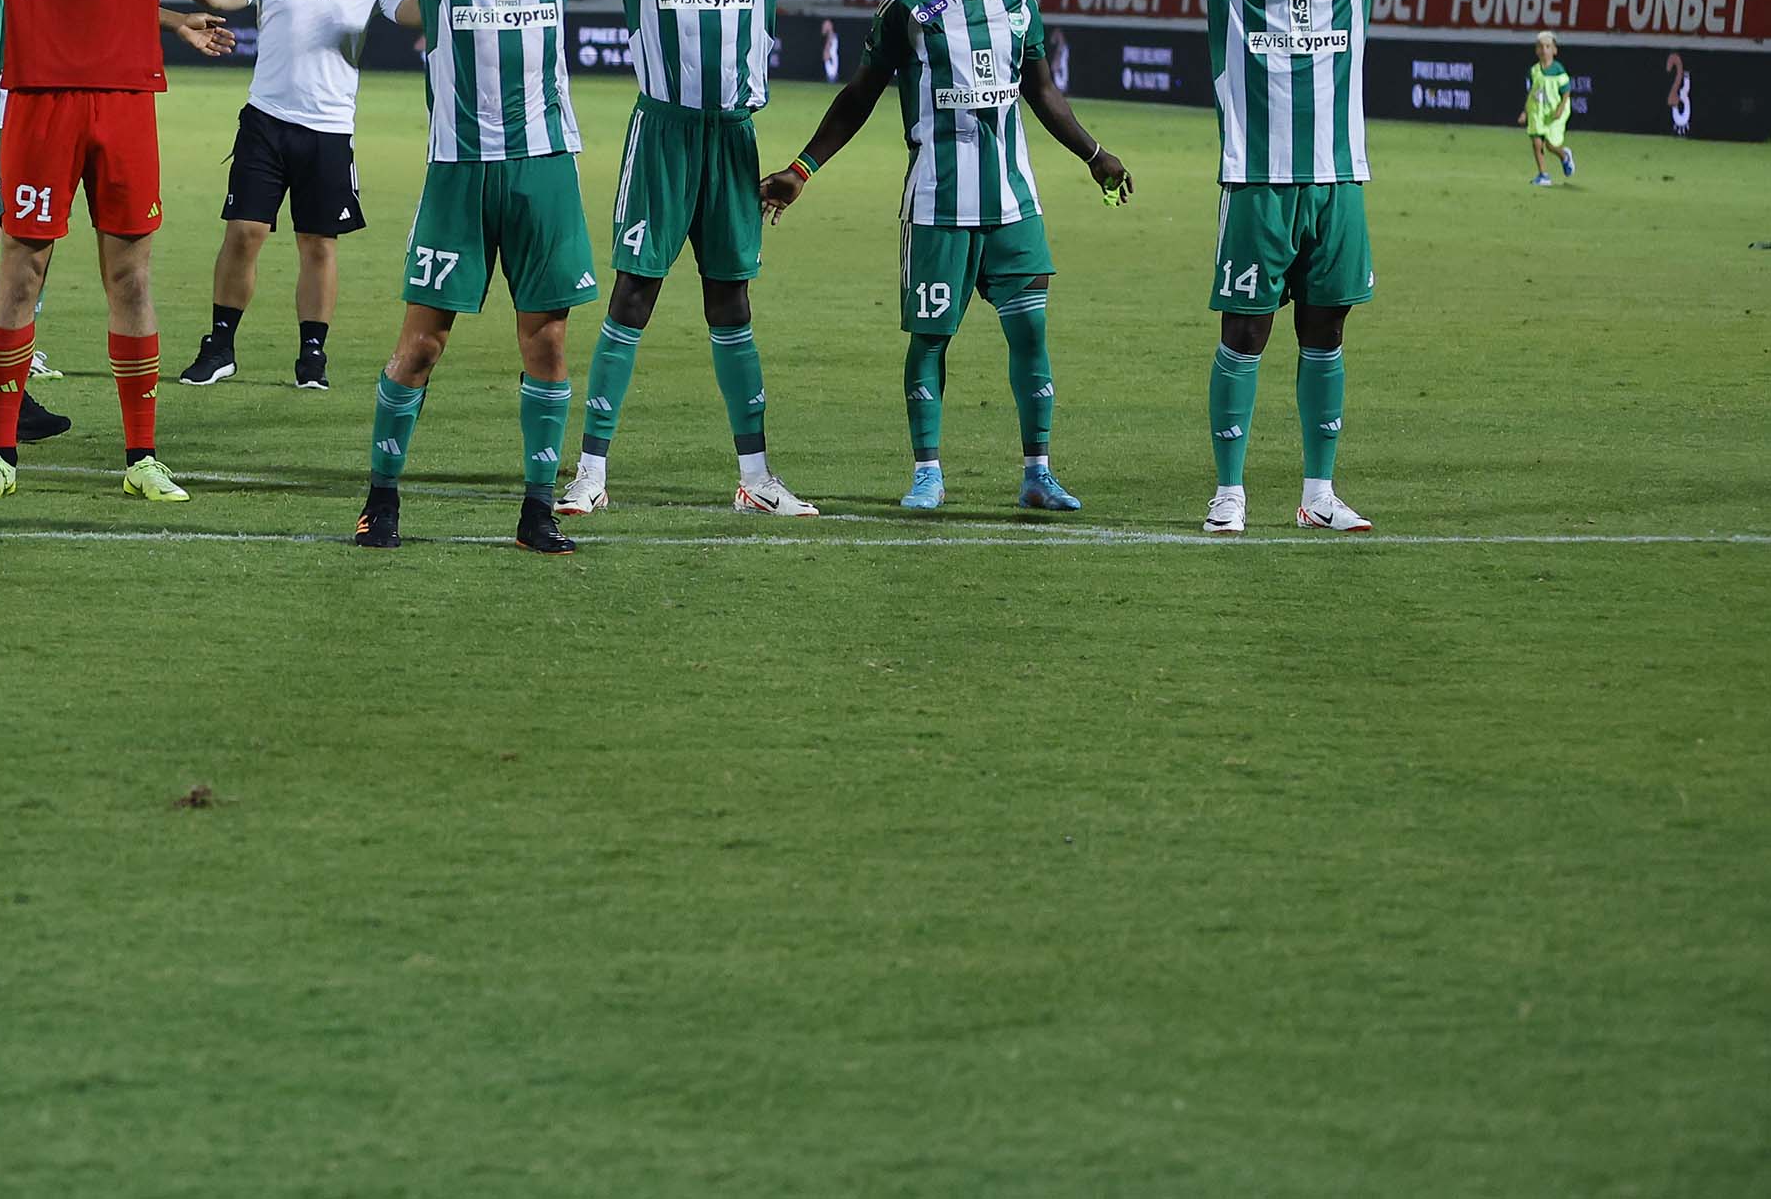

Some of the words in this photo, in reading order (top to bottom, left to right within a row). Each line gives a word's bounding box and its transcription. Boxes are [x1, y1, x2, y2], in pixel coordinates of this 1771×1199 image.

[16, 184, 53, 223] 91
[622, 219, 647, 256] 4
[409, 245, 460, 290] 37
[1219, 259, 1260, 300] 14
[915, 282, 951, 318] 19
